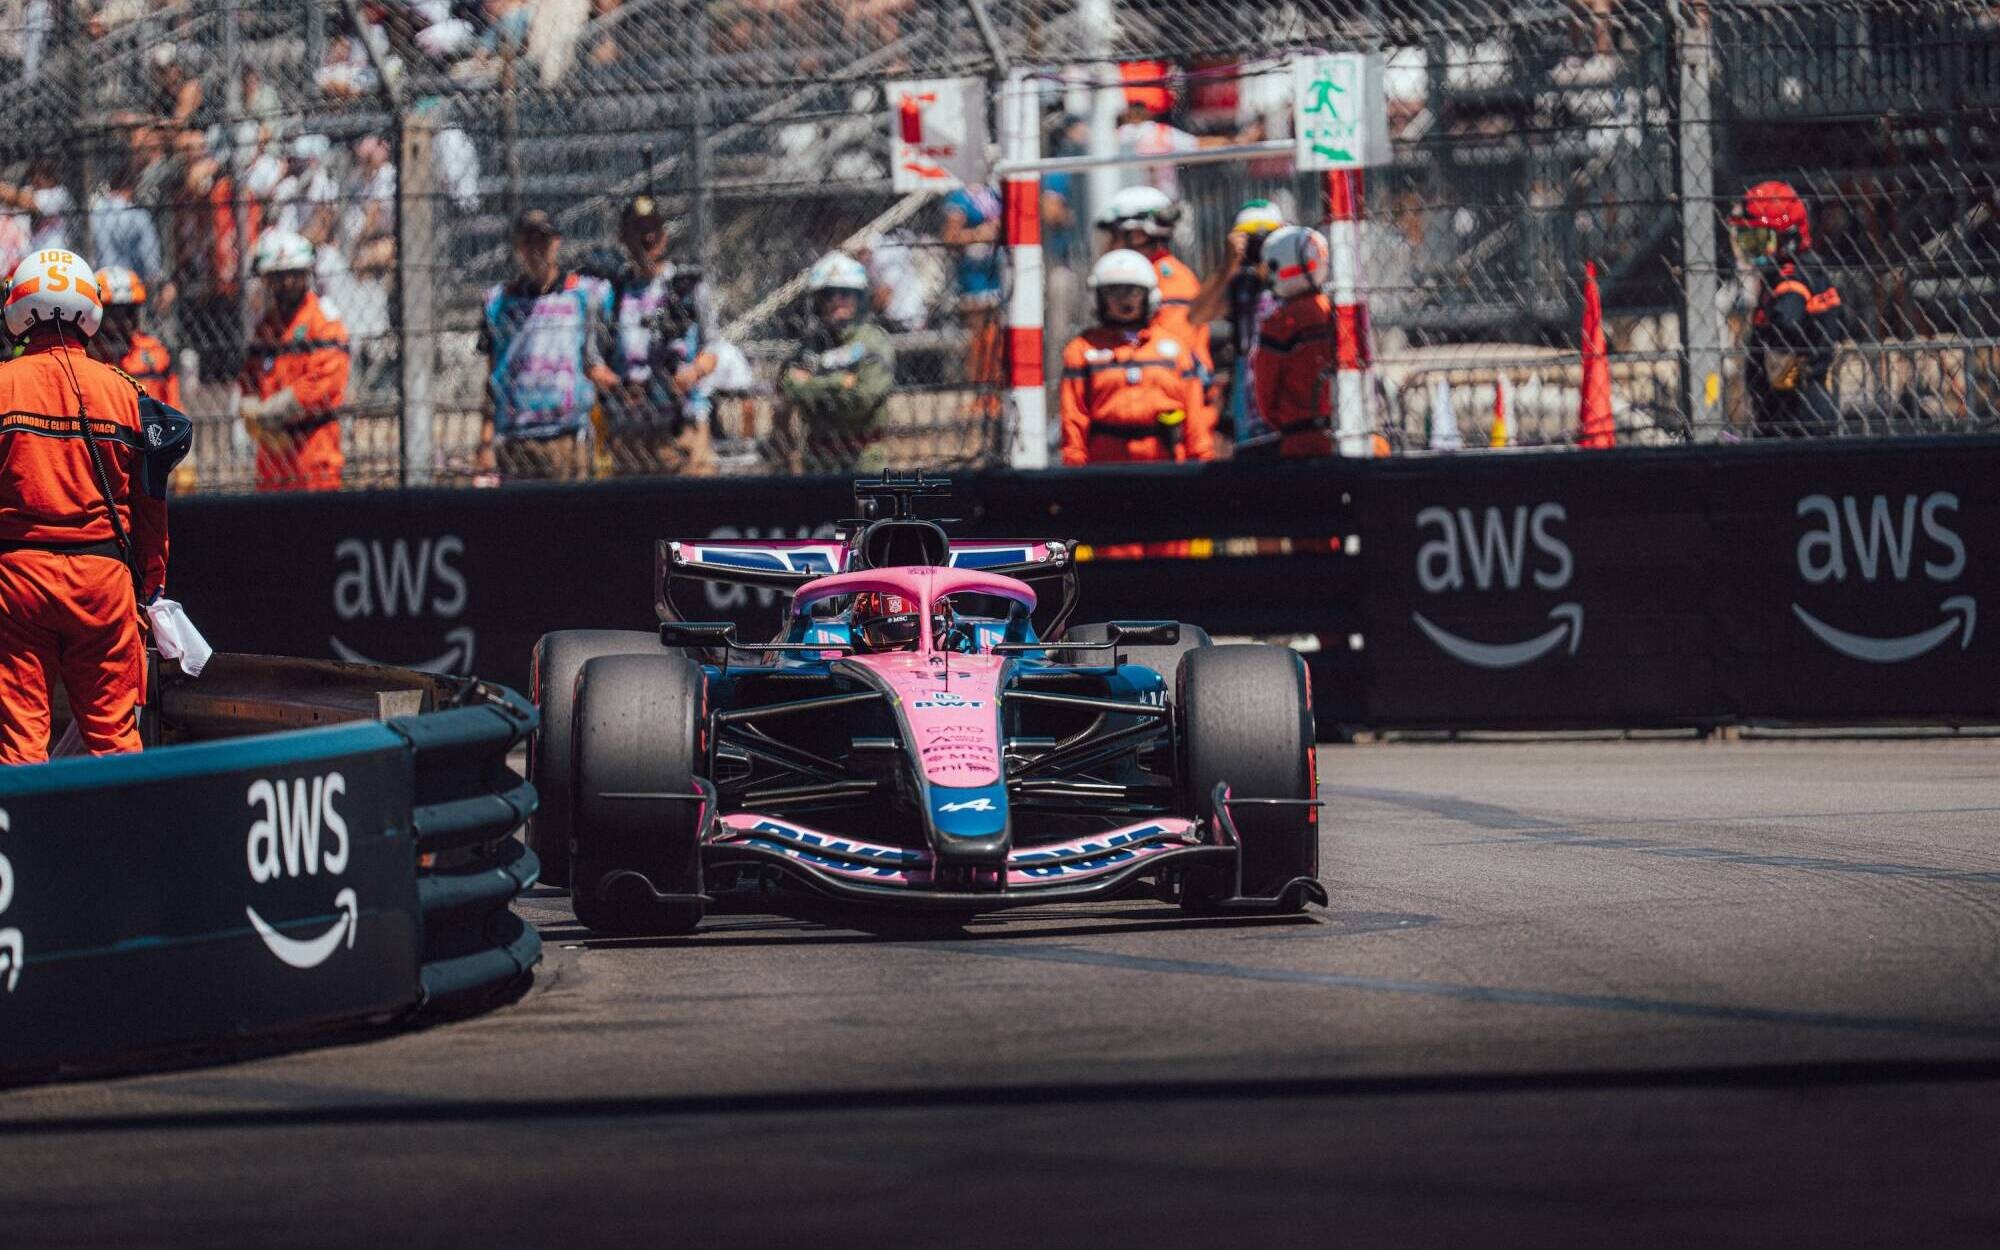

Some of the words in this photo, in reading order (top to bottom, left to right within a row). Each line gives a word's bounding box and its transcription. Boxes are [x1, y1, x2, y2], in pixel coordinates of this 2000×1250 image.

[40, 251, 73, 264] 102
[3, 415, 50, 430] AUTOMOBILE
[51, 421, 70, 430] CLUB
[334, 535, 467, 618] aws
[1416, 501, 1574, 593] aws
[1797, 491, 1967, 583] aws
[246, 771, 349, 884] aws
